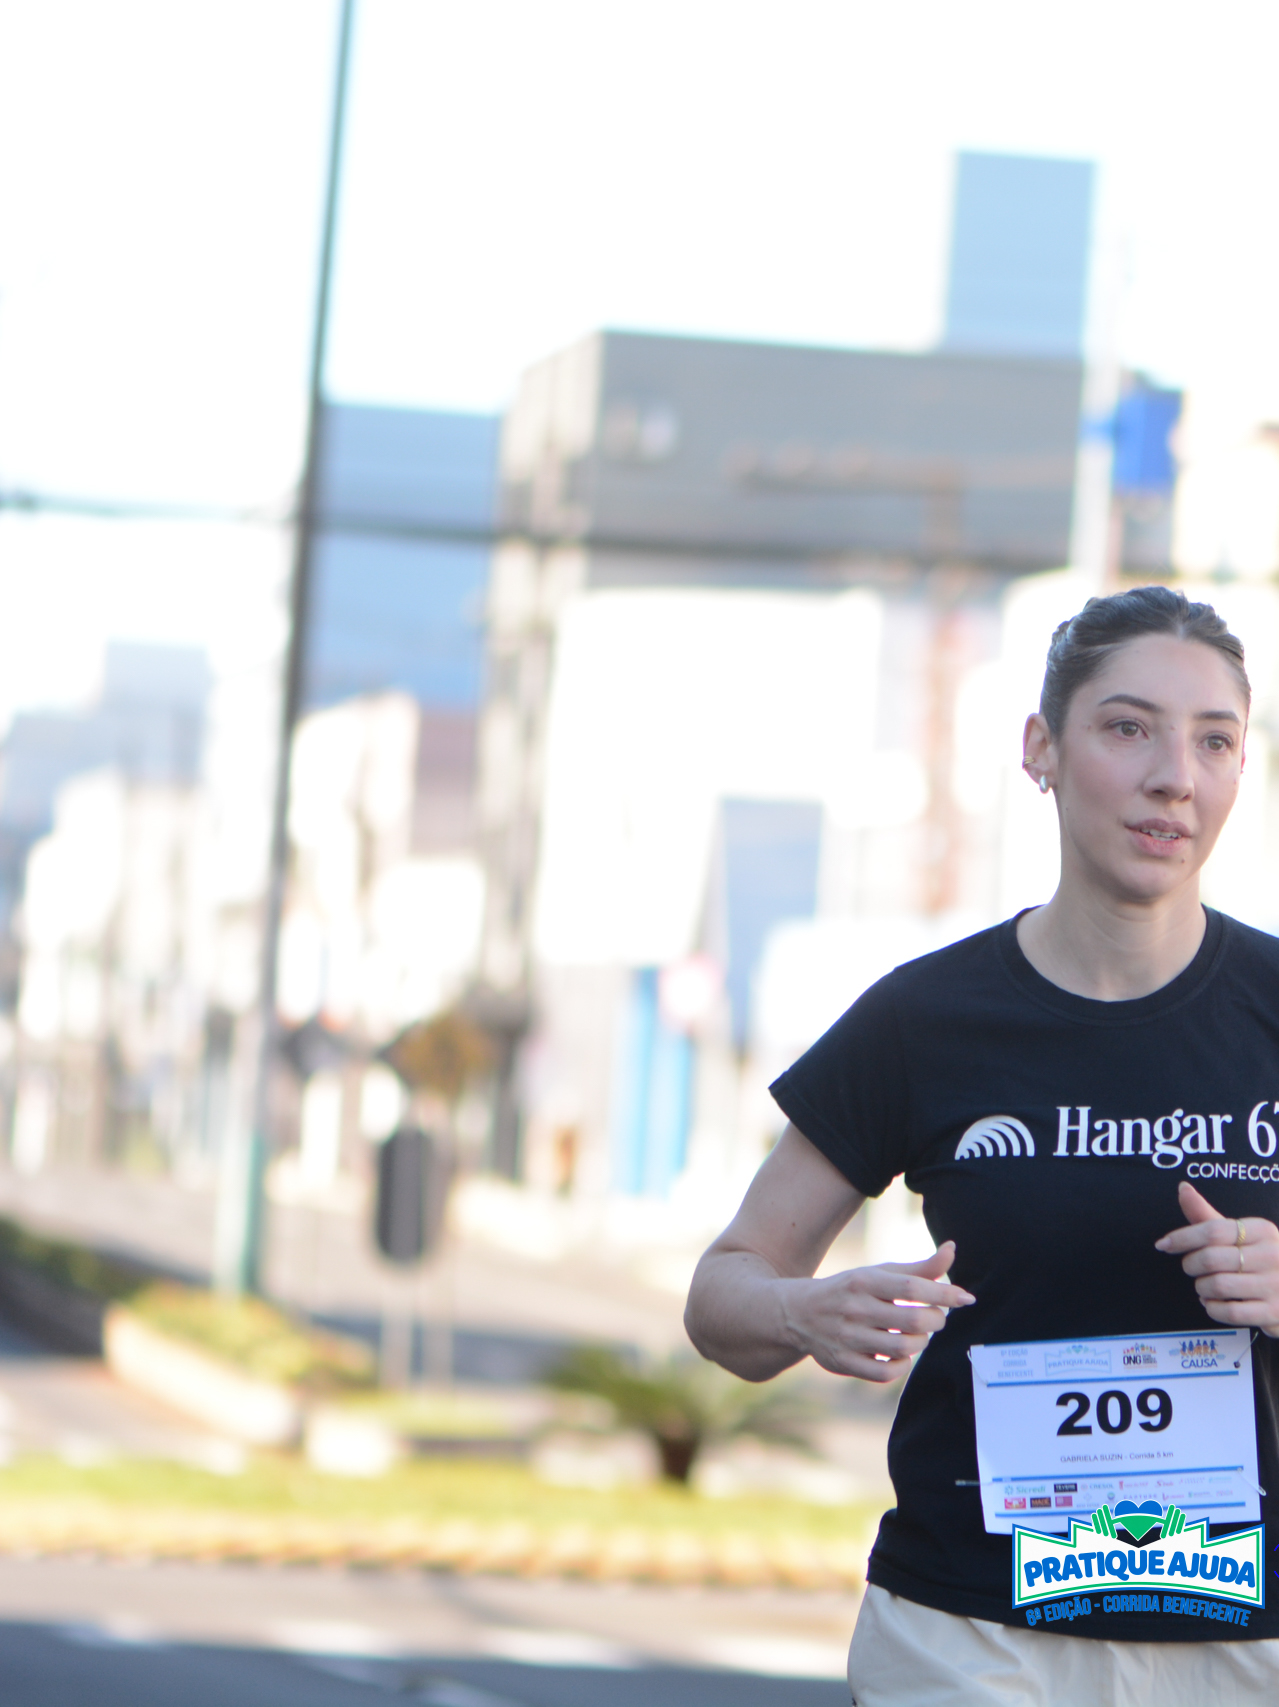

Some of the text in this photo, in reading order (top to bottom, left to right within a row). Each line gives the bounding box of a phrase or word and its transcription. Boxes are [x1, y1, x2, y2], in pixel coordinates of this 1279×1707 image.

[1053, 1106, 1233, 1169] Hangar
[1123, 1355, 1141, 1365] ONG
[1181, 1358, 1218, 1369] CAUSA
[1056, 1388, 1173, 1437] 209
[1060, 1454, 1099, 1463] GABRIELA
[1100, 1453, 1123, 1461] SUZIN
[1129, 1452, 1155, 1460] Corrida
